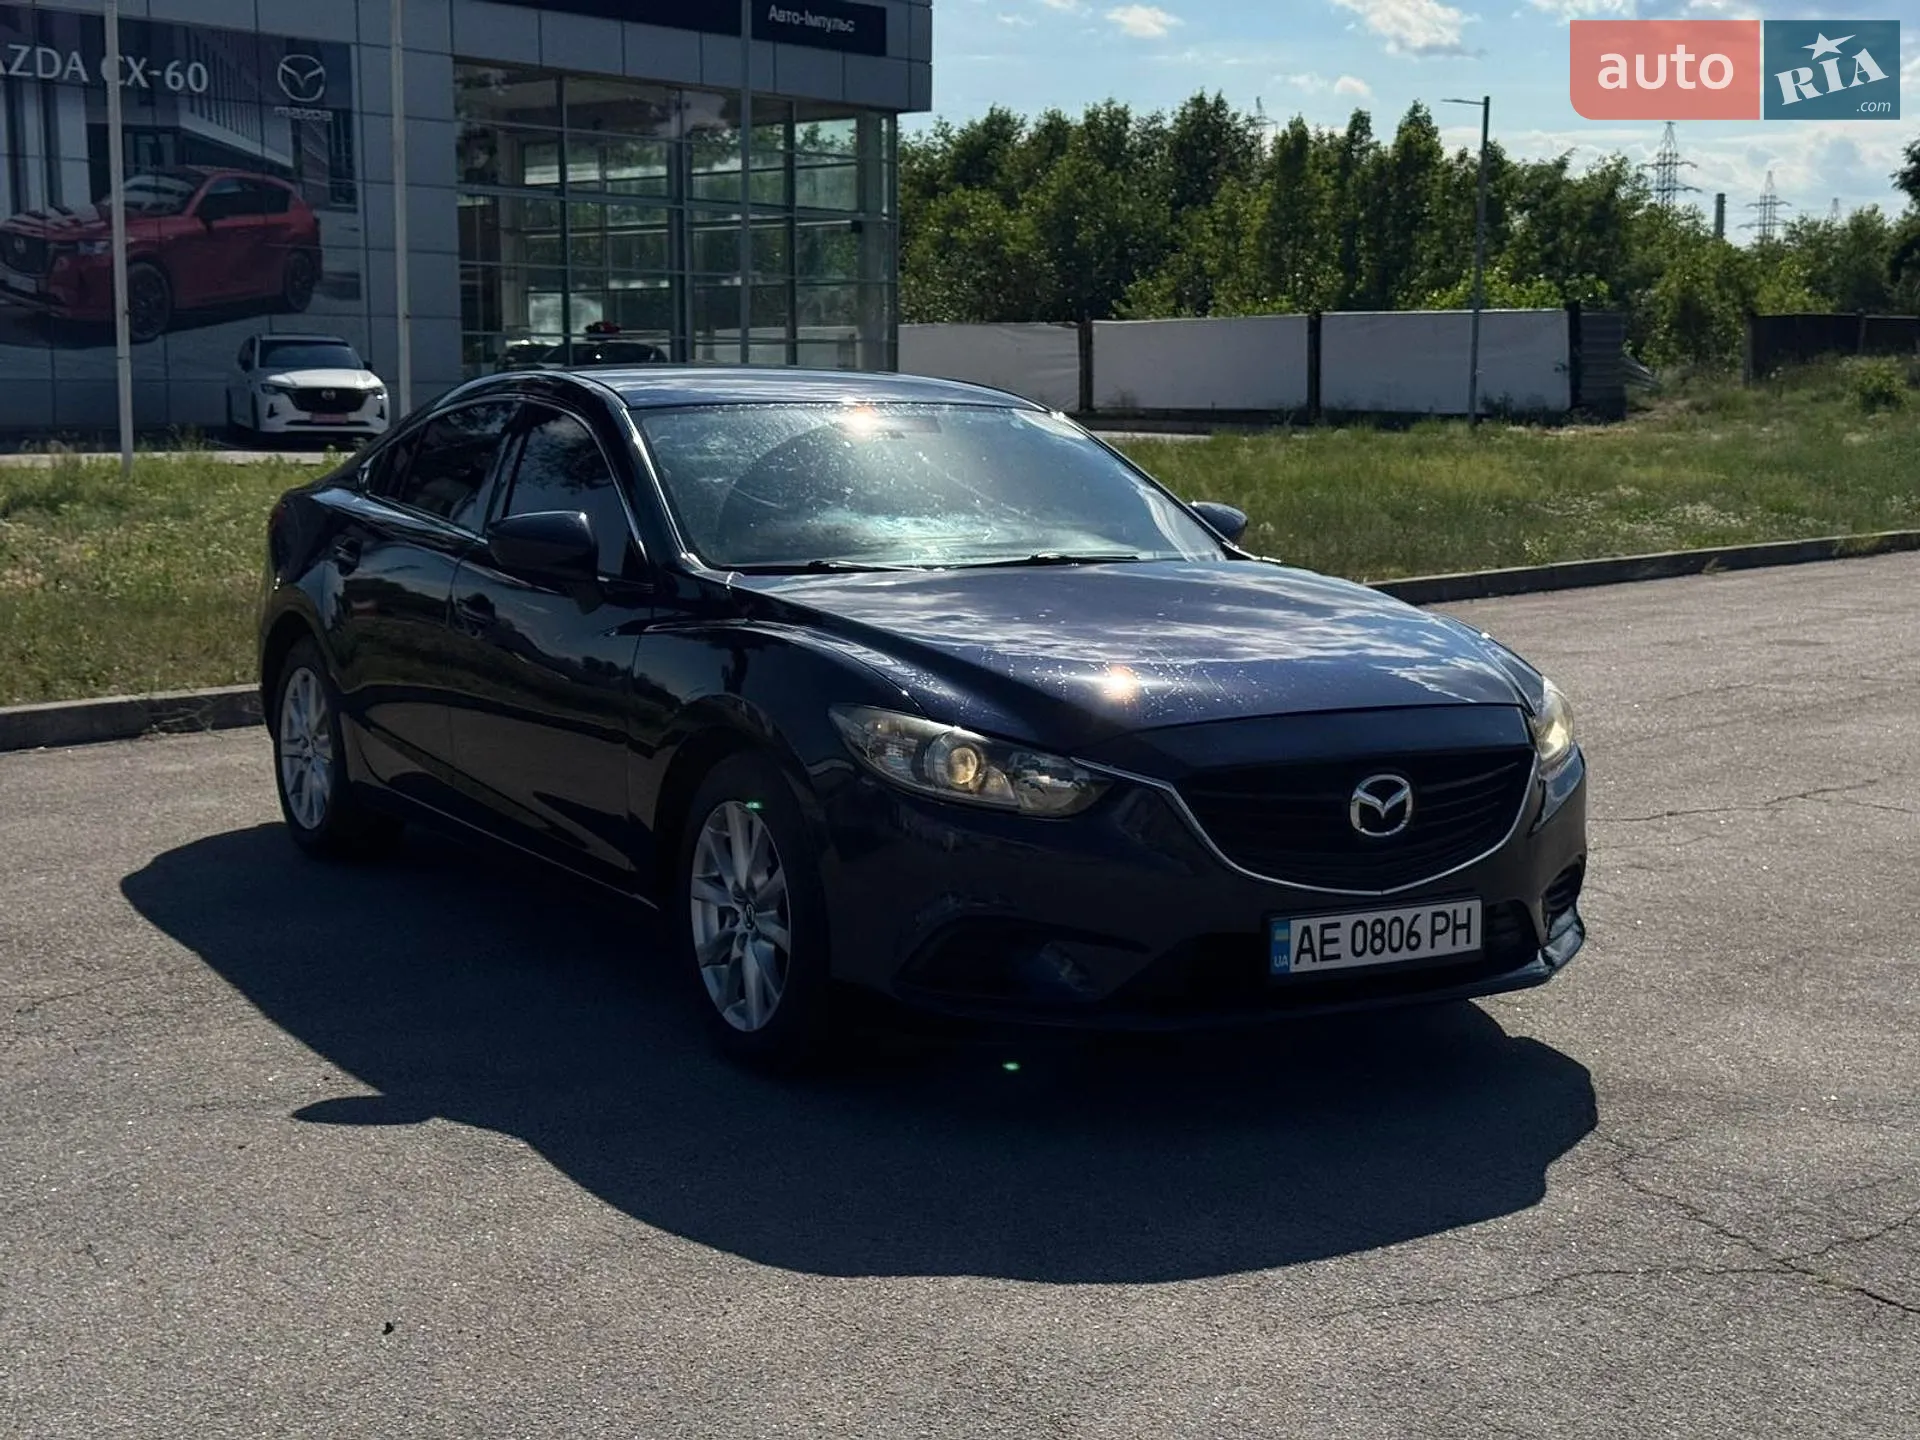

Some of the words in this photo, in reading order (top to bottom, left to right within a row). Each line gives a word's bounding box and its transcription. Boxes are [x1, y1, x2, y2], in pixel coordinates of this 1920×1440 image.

[0, 44, 90, 82] ZDA
[1294, 922, 1342, 965] AE
[1351, 912, 1422, 958] 0806
[1429, 907, 1472, 949] PH
[1273, 954, 1288, 968] UA
